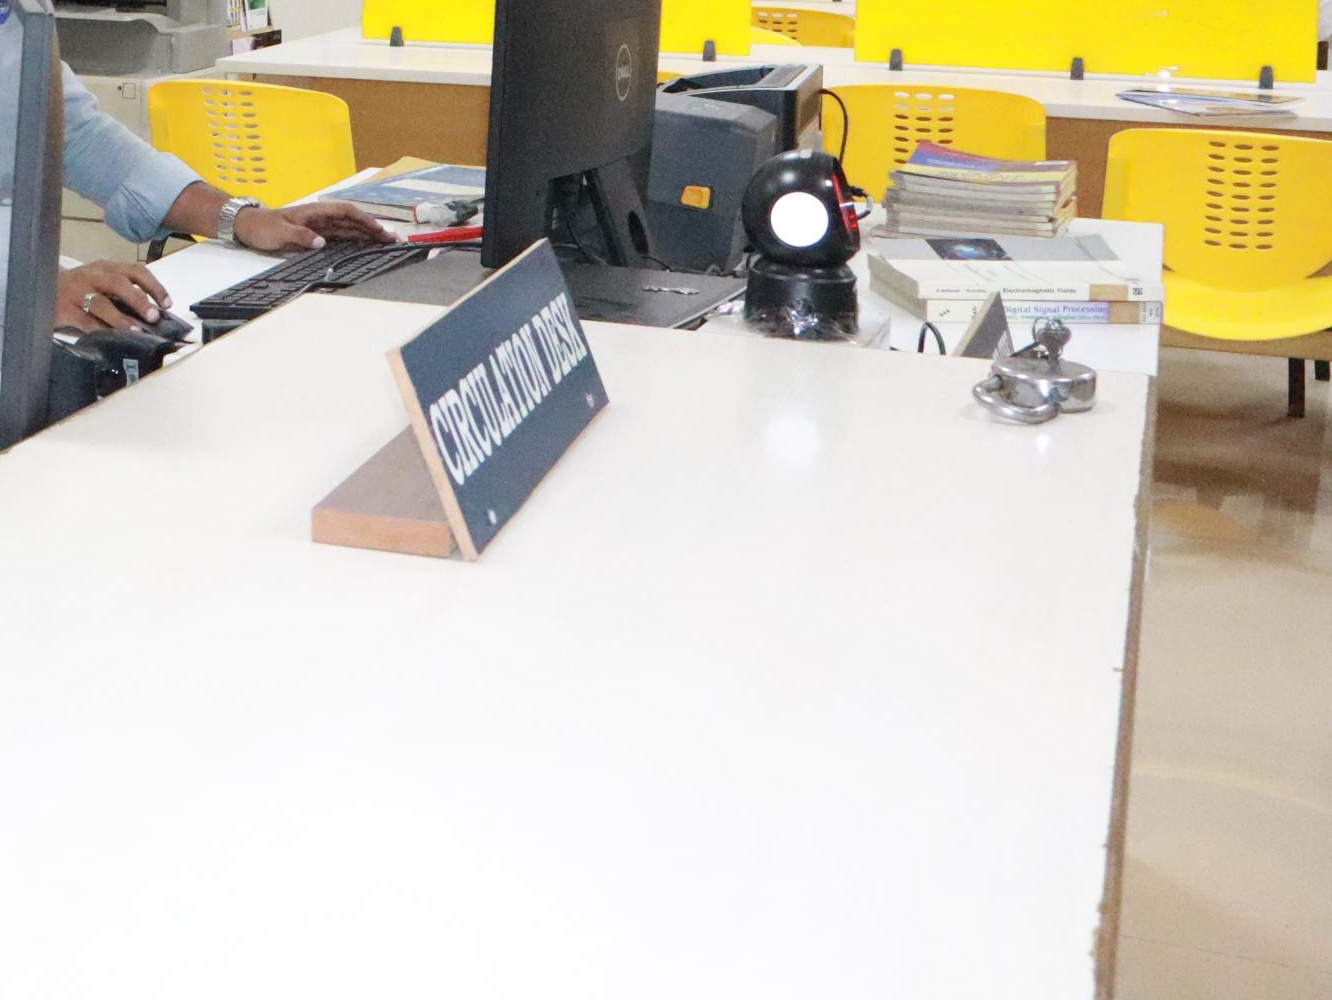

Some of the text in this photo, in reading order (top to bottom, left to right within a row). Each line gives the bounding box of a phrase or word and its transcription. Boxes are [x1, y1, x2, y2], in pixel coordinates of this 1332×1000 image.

[1004, 304, 1109, 314] Digital Signal Processing
[430, 292, 587, 485] CIRCULATION DESK
